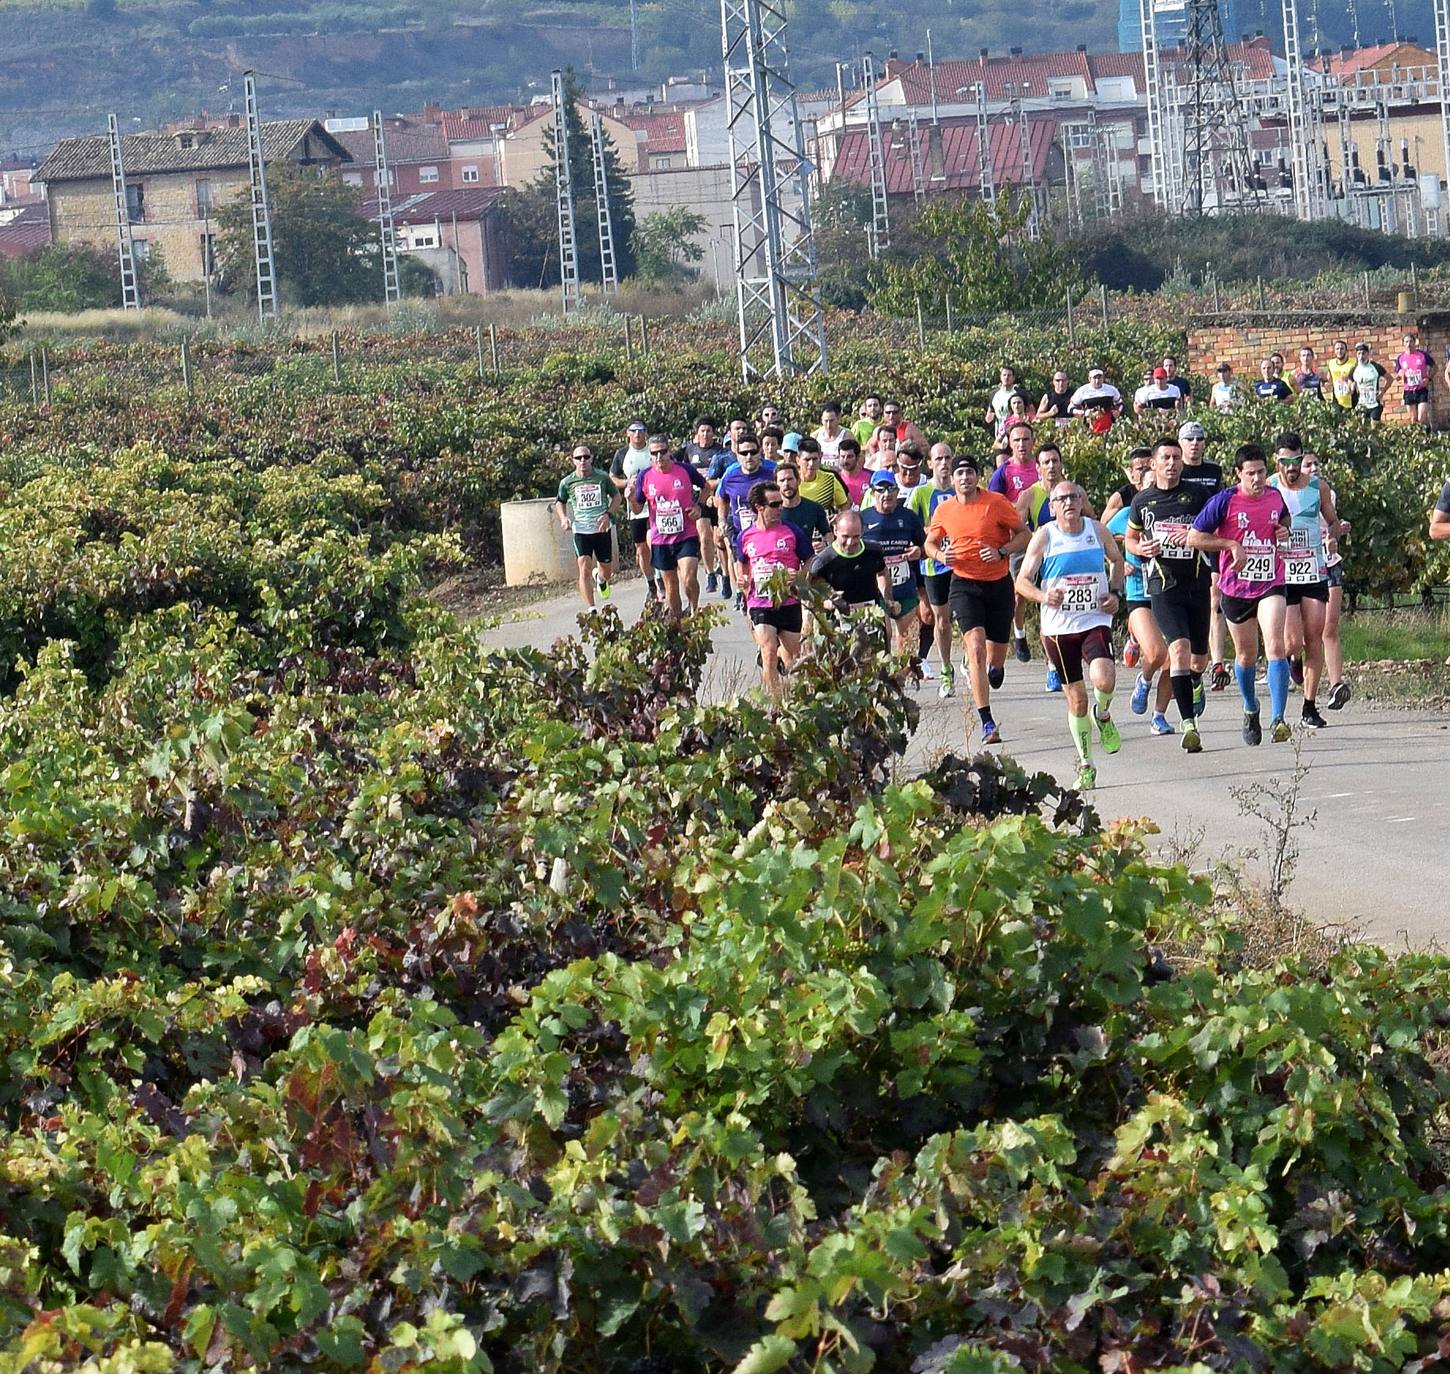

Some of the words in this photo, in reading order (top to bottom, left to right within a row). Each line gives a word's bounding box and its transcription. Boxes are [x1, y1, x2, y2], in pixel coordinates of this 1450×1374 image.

[1247, 558, 1270, 572] 249
[1290, 562, 1311, 575] 922
[1068, 588, 1092, 603] 283
